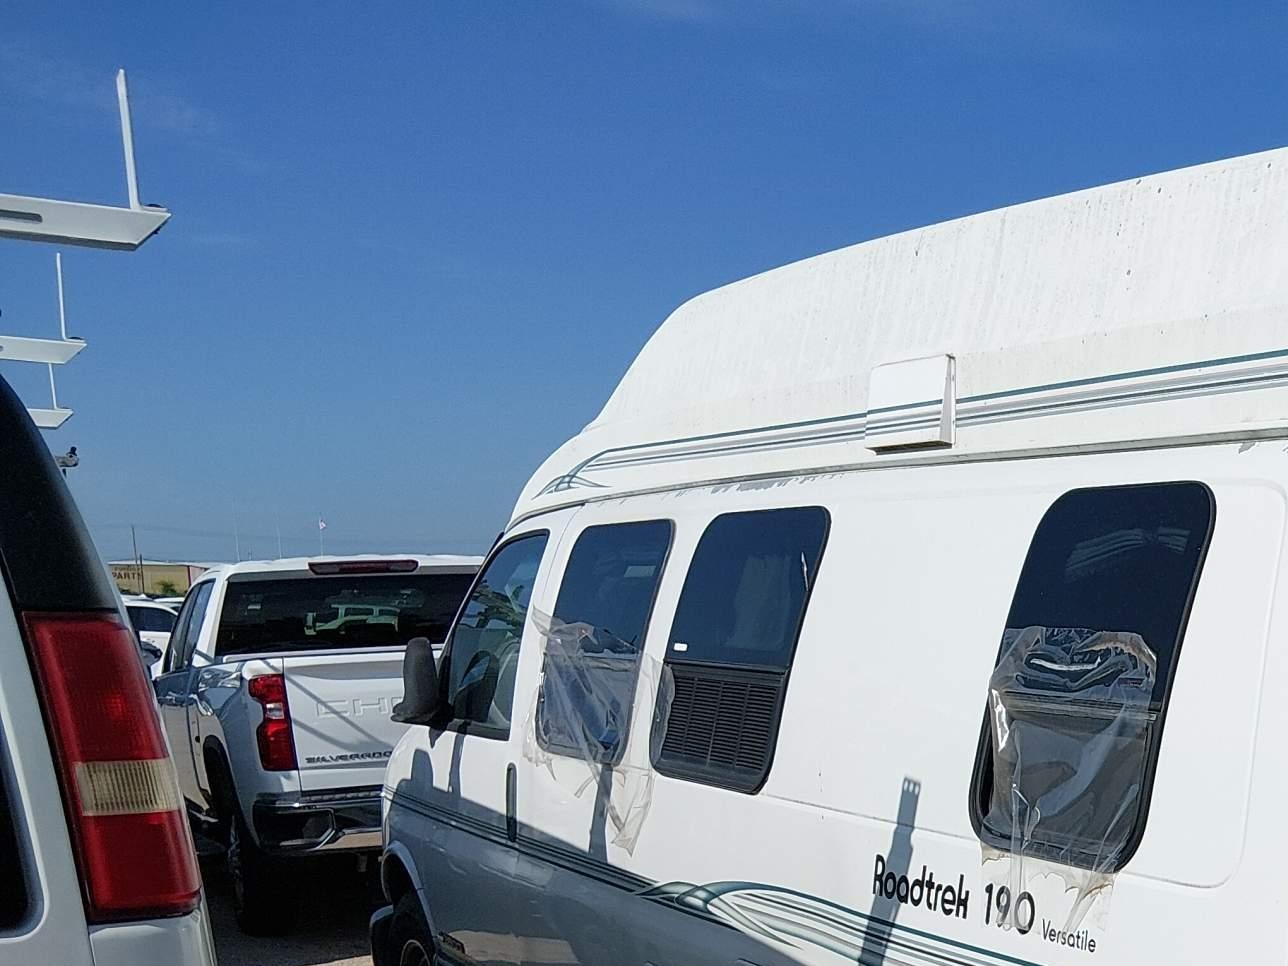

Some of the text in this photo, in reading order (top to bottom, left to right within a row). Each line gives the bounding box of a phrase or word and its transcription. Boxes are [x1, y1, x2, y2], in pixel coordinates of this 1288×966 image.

[304, 751, 392, 764] SILVERADO
[872, 854, 1097, 953] Roadtrek 190 Versatile
